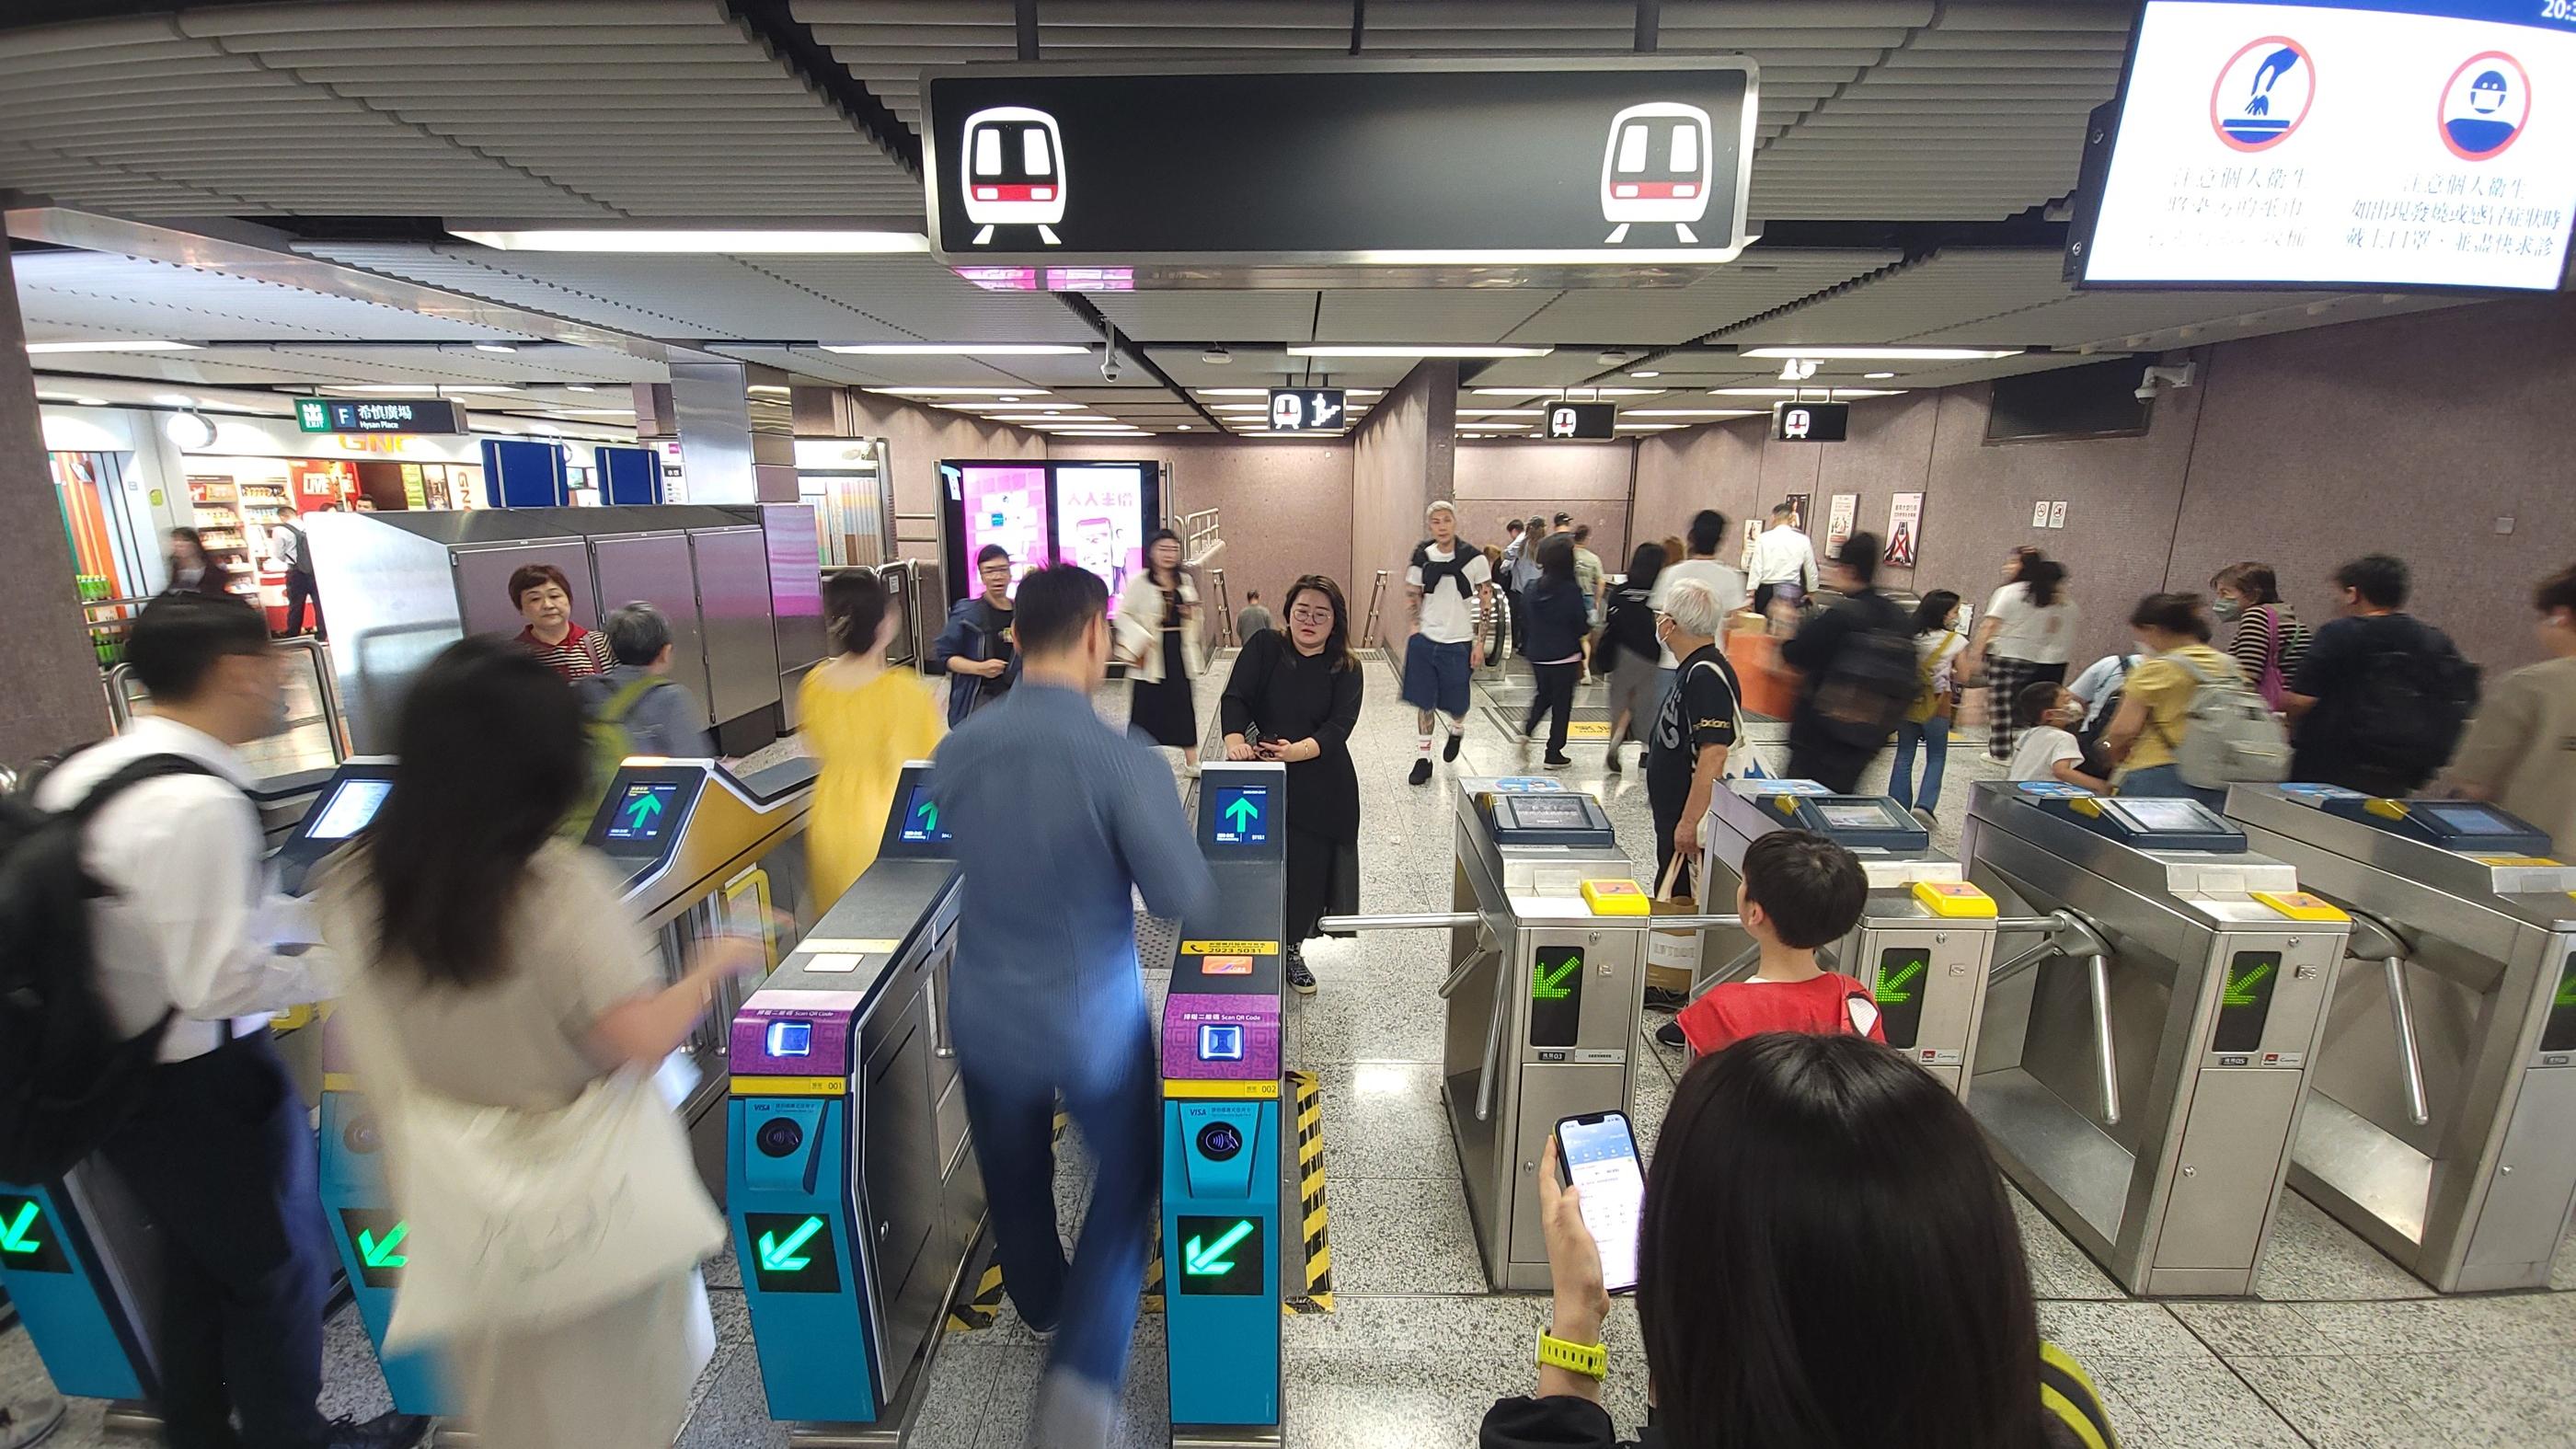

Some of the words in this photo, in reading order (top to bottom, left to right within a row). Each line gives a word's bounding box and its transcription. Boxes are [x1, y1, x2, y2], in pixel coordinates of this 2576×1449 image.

[339, 408, 350, 424] F
[357, 405, 412, 420] 希慎廣場
[360, 420, 379, 430] Hysan
[381, 420, 399, 429] Place
[828, 1082, 842, 1090] 001
[1261, 1085, 1277, 1093] 002
[1189, 1108, 1207, 1117] VISA
